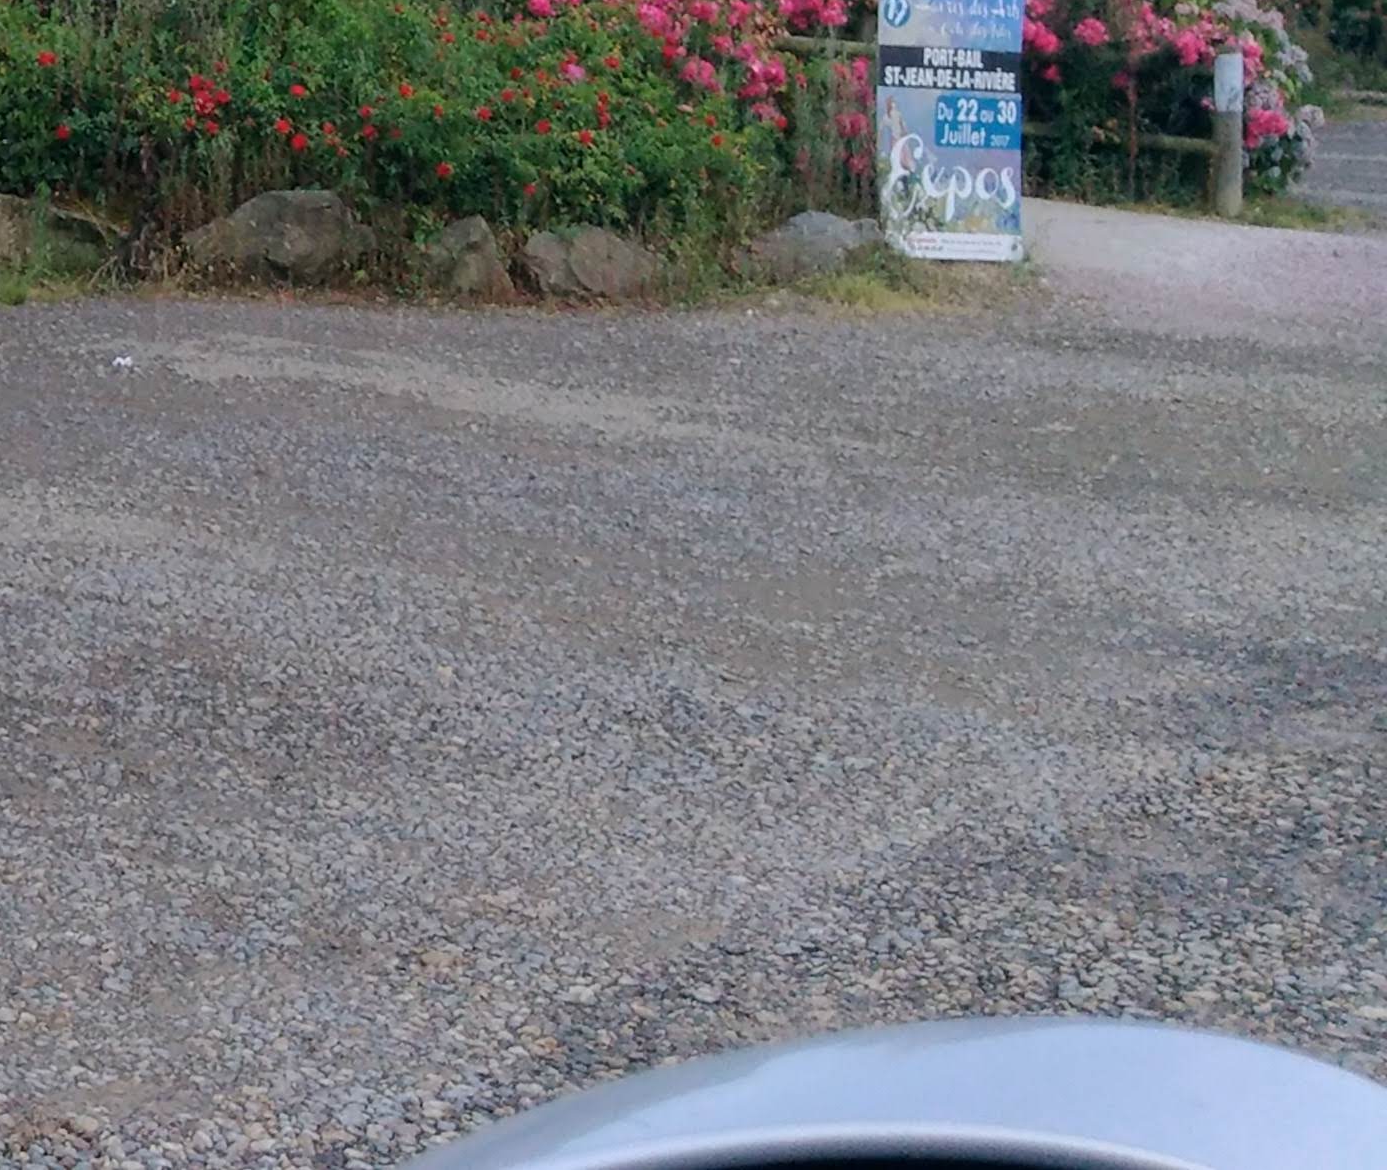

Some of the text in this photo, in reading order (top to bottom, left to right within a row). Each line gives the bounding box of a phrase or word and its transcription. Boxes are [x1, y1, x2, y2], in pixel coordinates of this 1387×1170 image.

[923, 47, 984, 68] PORT-BAIL
[884, 66, 1015, 91] ST-JEAN-DE-LA-RIVIÈRE
[937, 99, 1017, 125] Du 22 au 30
[940, 124, 986, 146] Juillet
[882, 134, 1017, 221] Expos
